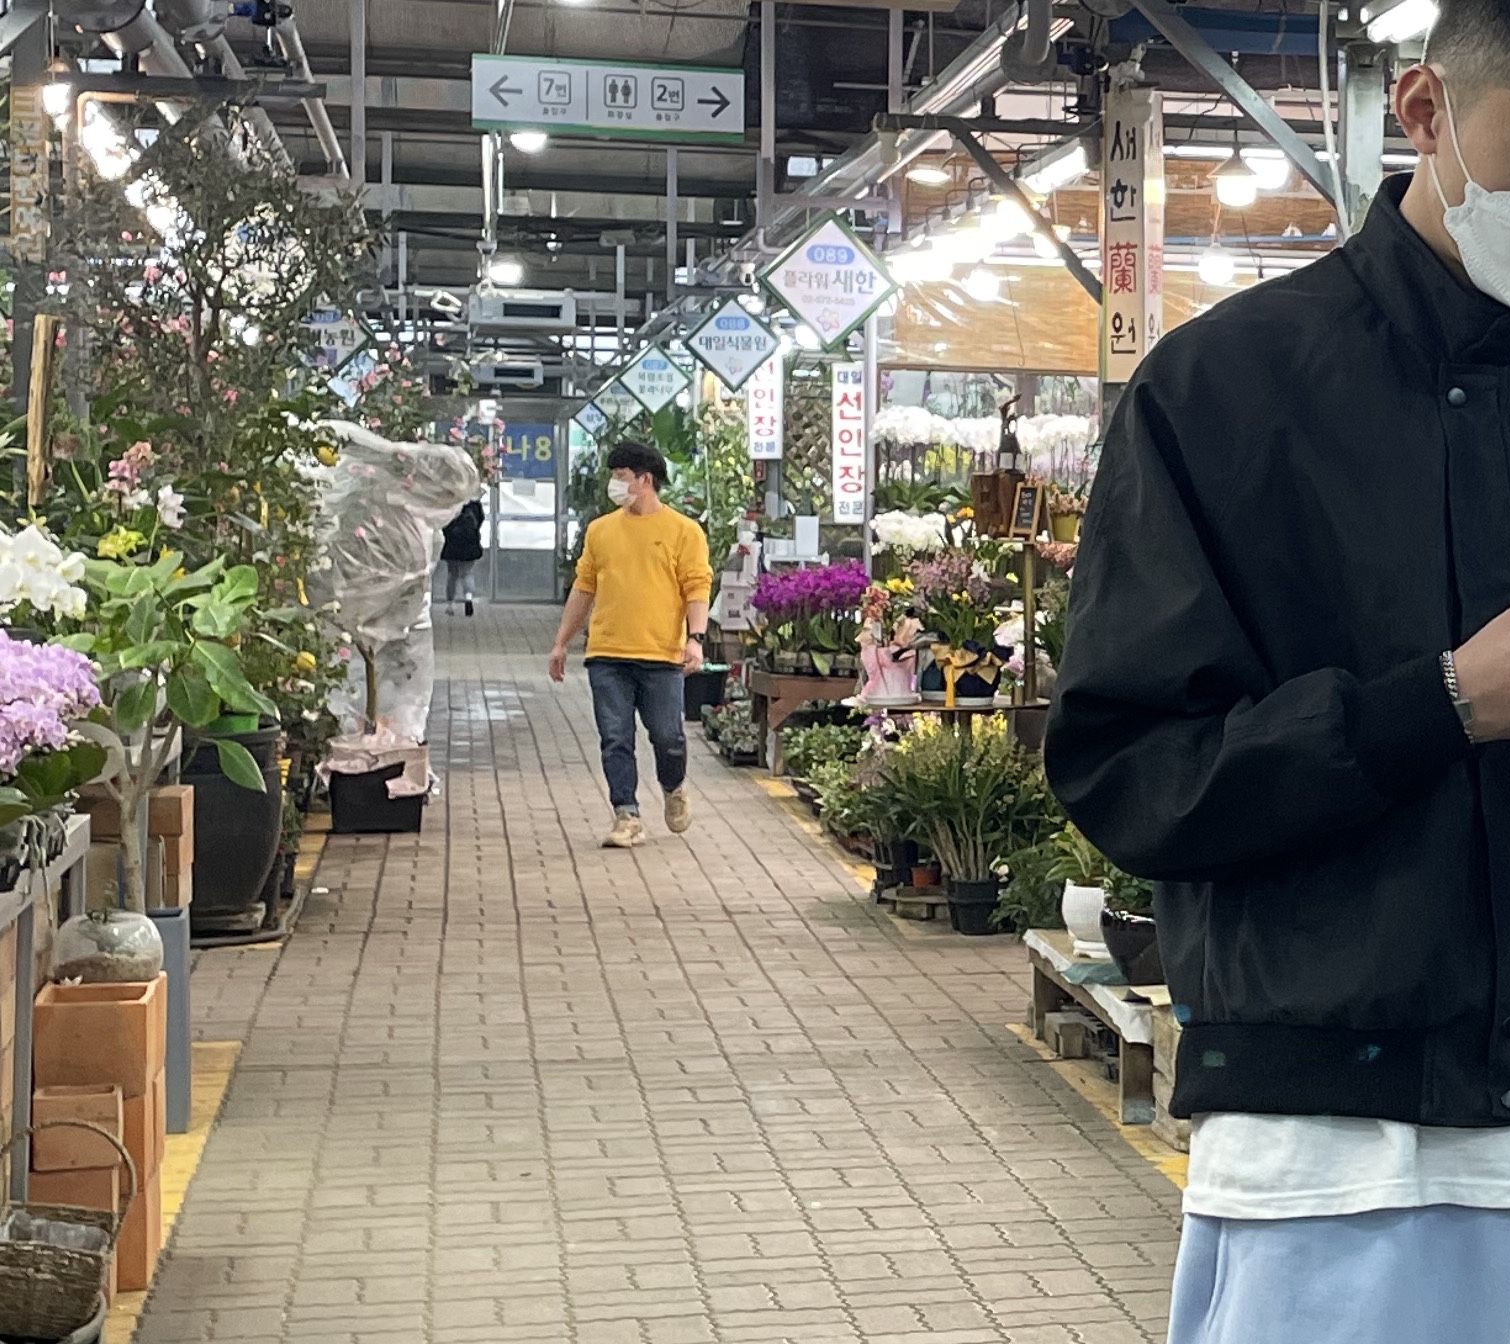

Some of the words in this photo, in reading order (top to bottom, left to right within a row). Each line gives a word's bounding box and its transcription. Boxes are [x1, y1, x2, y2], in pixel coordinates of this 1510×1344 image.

[543, 77, 567, 98] 7번
[656, 84, 680, 104] 2번
[813, 247, 849, 263] 089
[832, 269, 877, 294] 새한
[698, 336, 767, 351] 대일식물원
[837, 371, 862, 384] 대일
[836, 391, 865, 493] 선인장
